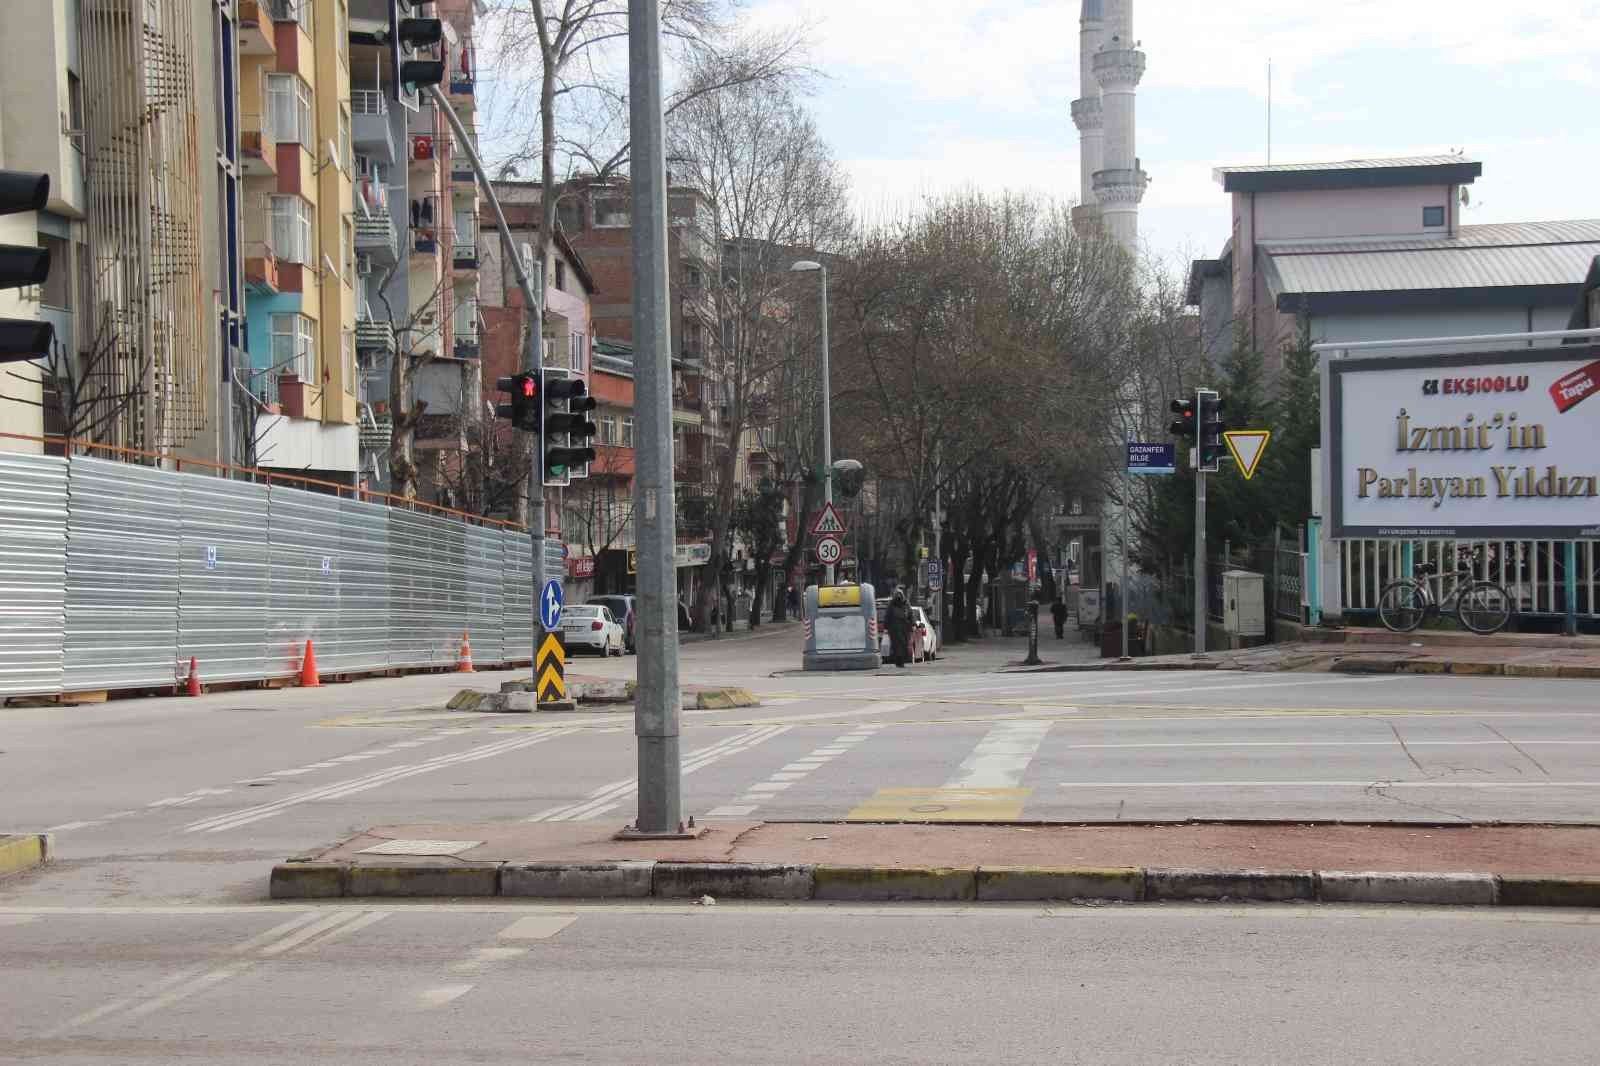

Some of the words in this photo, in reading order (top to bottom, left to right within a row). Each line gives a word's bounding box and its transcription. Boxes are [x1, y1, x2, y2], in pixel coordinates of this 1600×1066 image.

[1559, 378, 1595, 400] Tapu
[1129, 446, 1164, 454] GAZANFER
[1357, 467, 1487, 508] Parlayan
[1490, 465, 1599, 498] Yıldızı
[821, 544, 838, 558] 30
